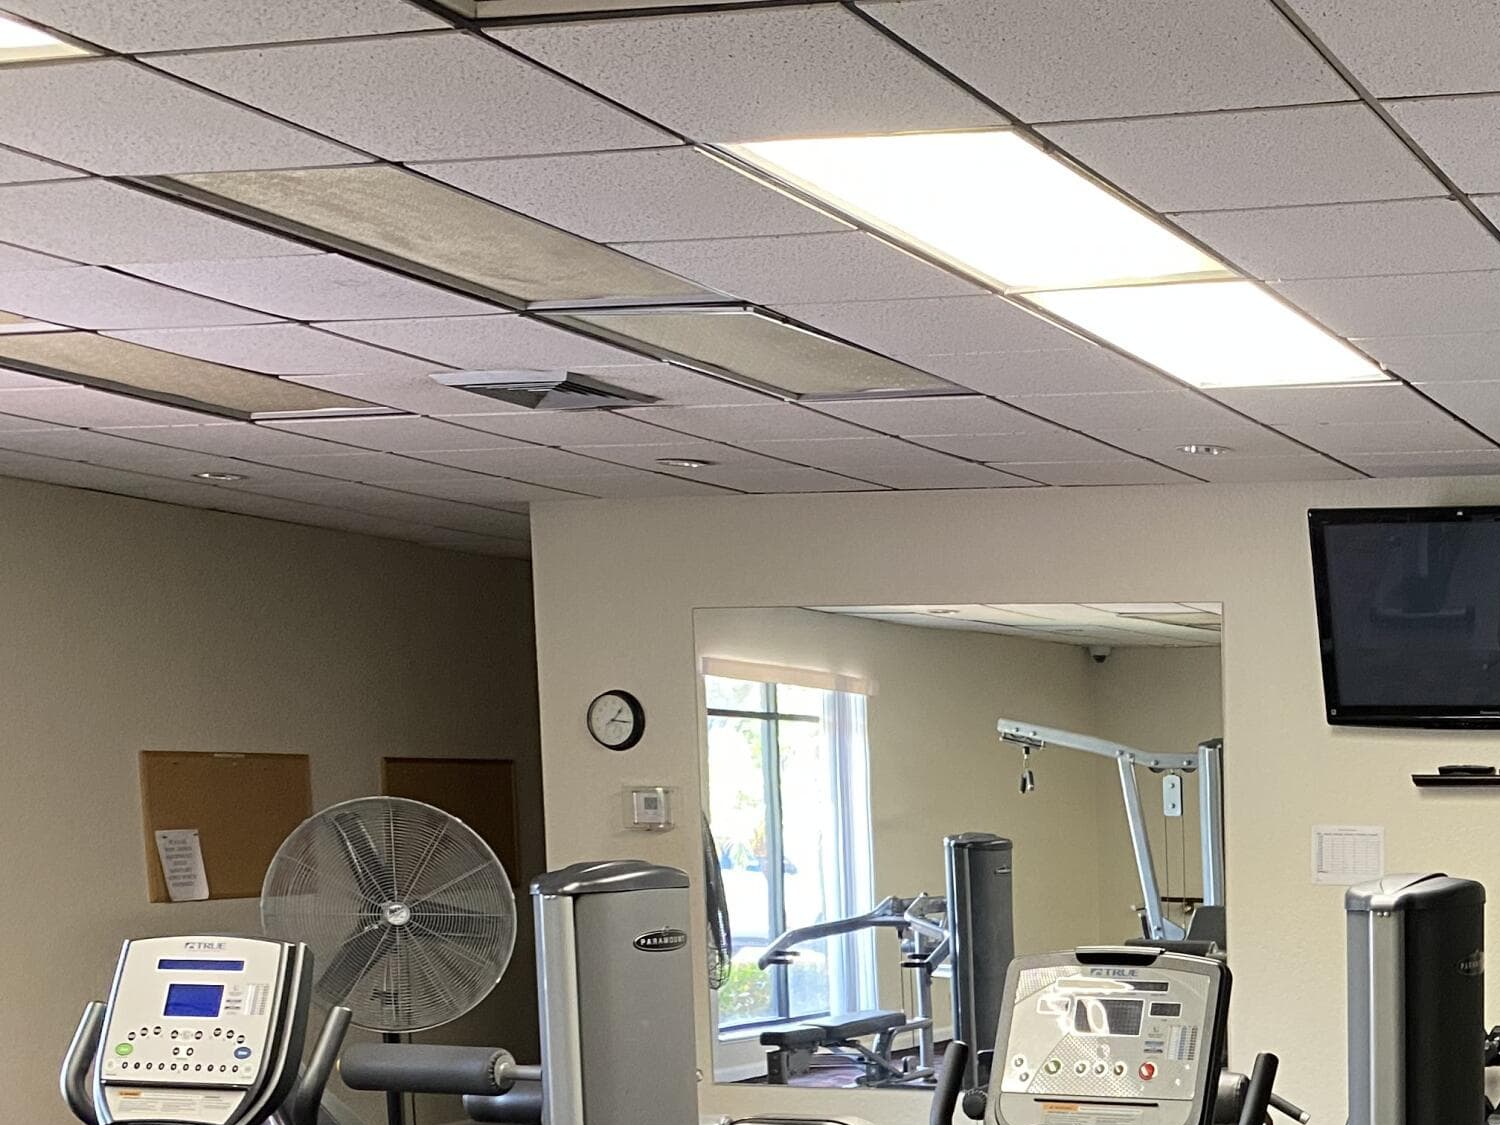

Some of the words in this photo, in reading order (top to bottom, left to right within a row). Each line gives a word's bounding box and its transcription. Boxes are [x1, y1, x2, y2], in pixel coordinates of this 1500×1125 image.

[640, 936, 685, 946] PARAMOUNT
[197, 942, 226, 950] TRUE
[1105, 968, 1138, 977] TRUE
